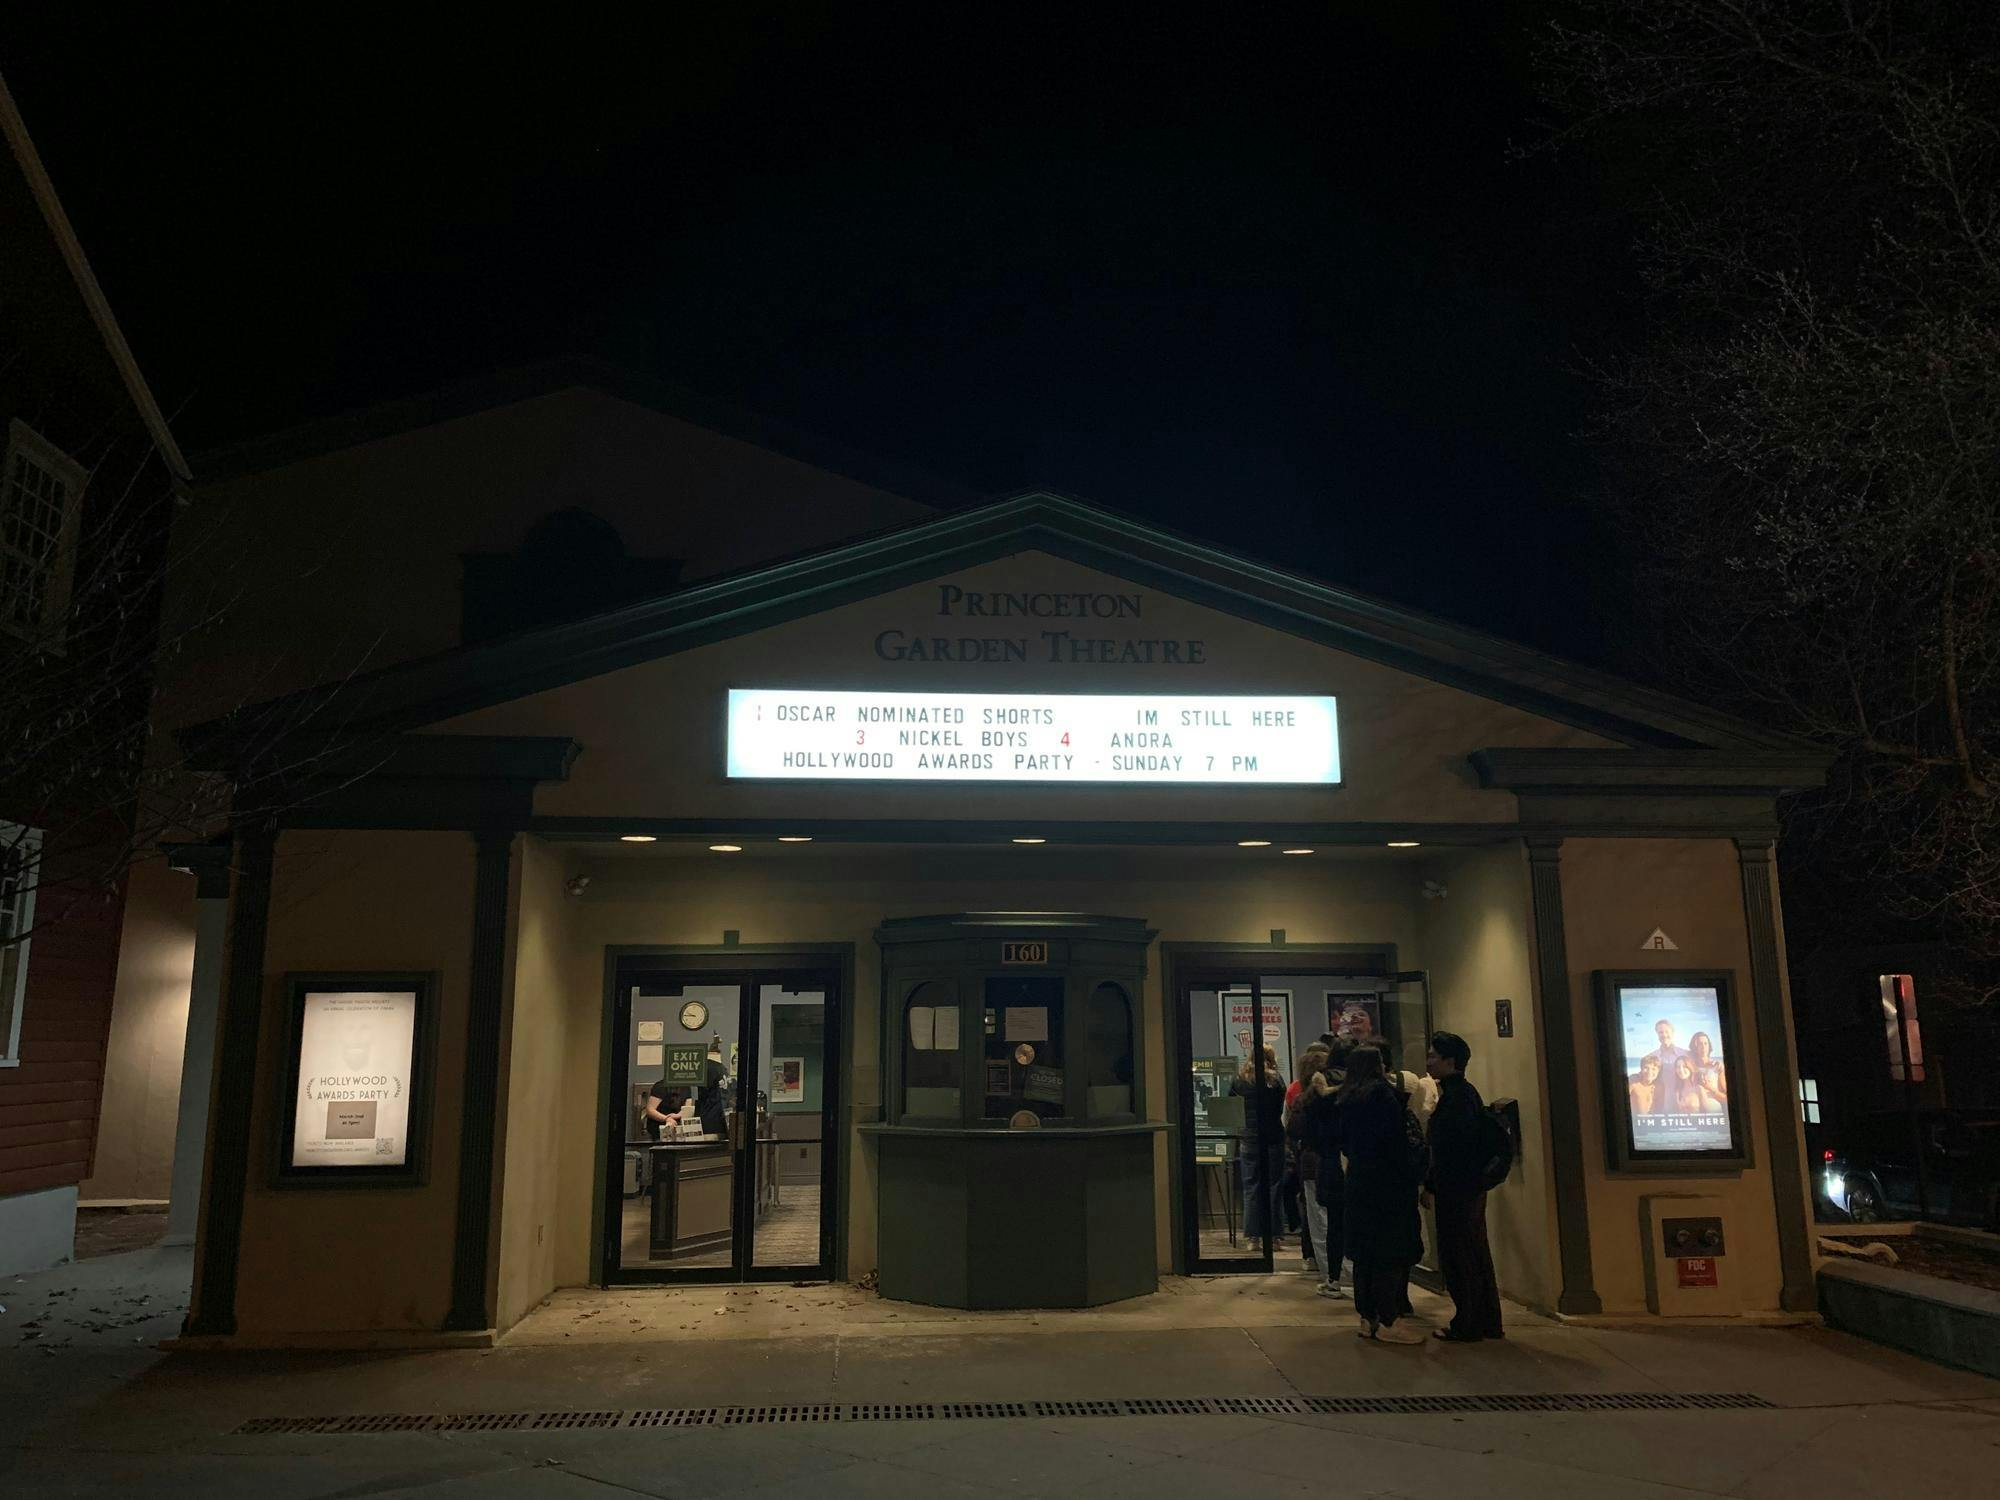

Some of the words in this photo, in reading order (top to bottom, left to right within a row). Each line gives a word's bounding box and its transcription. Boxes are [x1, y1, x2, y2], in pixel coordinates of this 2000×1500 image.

[777, 705, 835, 722] OSCAR
[858, 706, 964, 724] NOMINATED
[983, 708, 1053, 724] SHORTS
[1137, 710, 1158, 726] IM
[1181, 710, 1232, 726] STILL
[1252, 710, 1295, 727] HERE
[856, 729, 865, 745] 3
[899, 730, 963, 746] NICKEL
[981, 731, 1027, 747] BOYS
[1061, 732, 1070, 747] 4
[1111, 732, 1173, 748] ANORA
[783, 752, 893, 768] HOLLYWOOD
[918, 753, 993, 769] AWARDS
[1014, 754, 1073, 771] PARTY
[1113, 755, 1182, 772] SUNDAY
[1206, 756, 1214, 771] 7
[1232, 756, 1258, 772] PM
[1654, 936, 1664, 948] R
[1009, 943, 1041, 961] 160
[673, 1052, 698, 1061] EXIT
[671, 1061, 700, 1071] ONLY
[320, 1076, 387, 1086] HOLLYWOOD
[1030, 1073, 1064, 1085] CLOSED
[317, 1090, 355, 1100] AWARDS
[359, 1090, 389, 1099] PARTY
[1637, 1119, 1655, 1127] I'M
[1661, 1118, 1692, 1127] STILL
[1698, 1117, 1726, 1126] HERE
[1687, 1259, 1706, 1271] FDC
